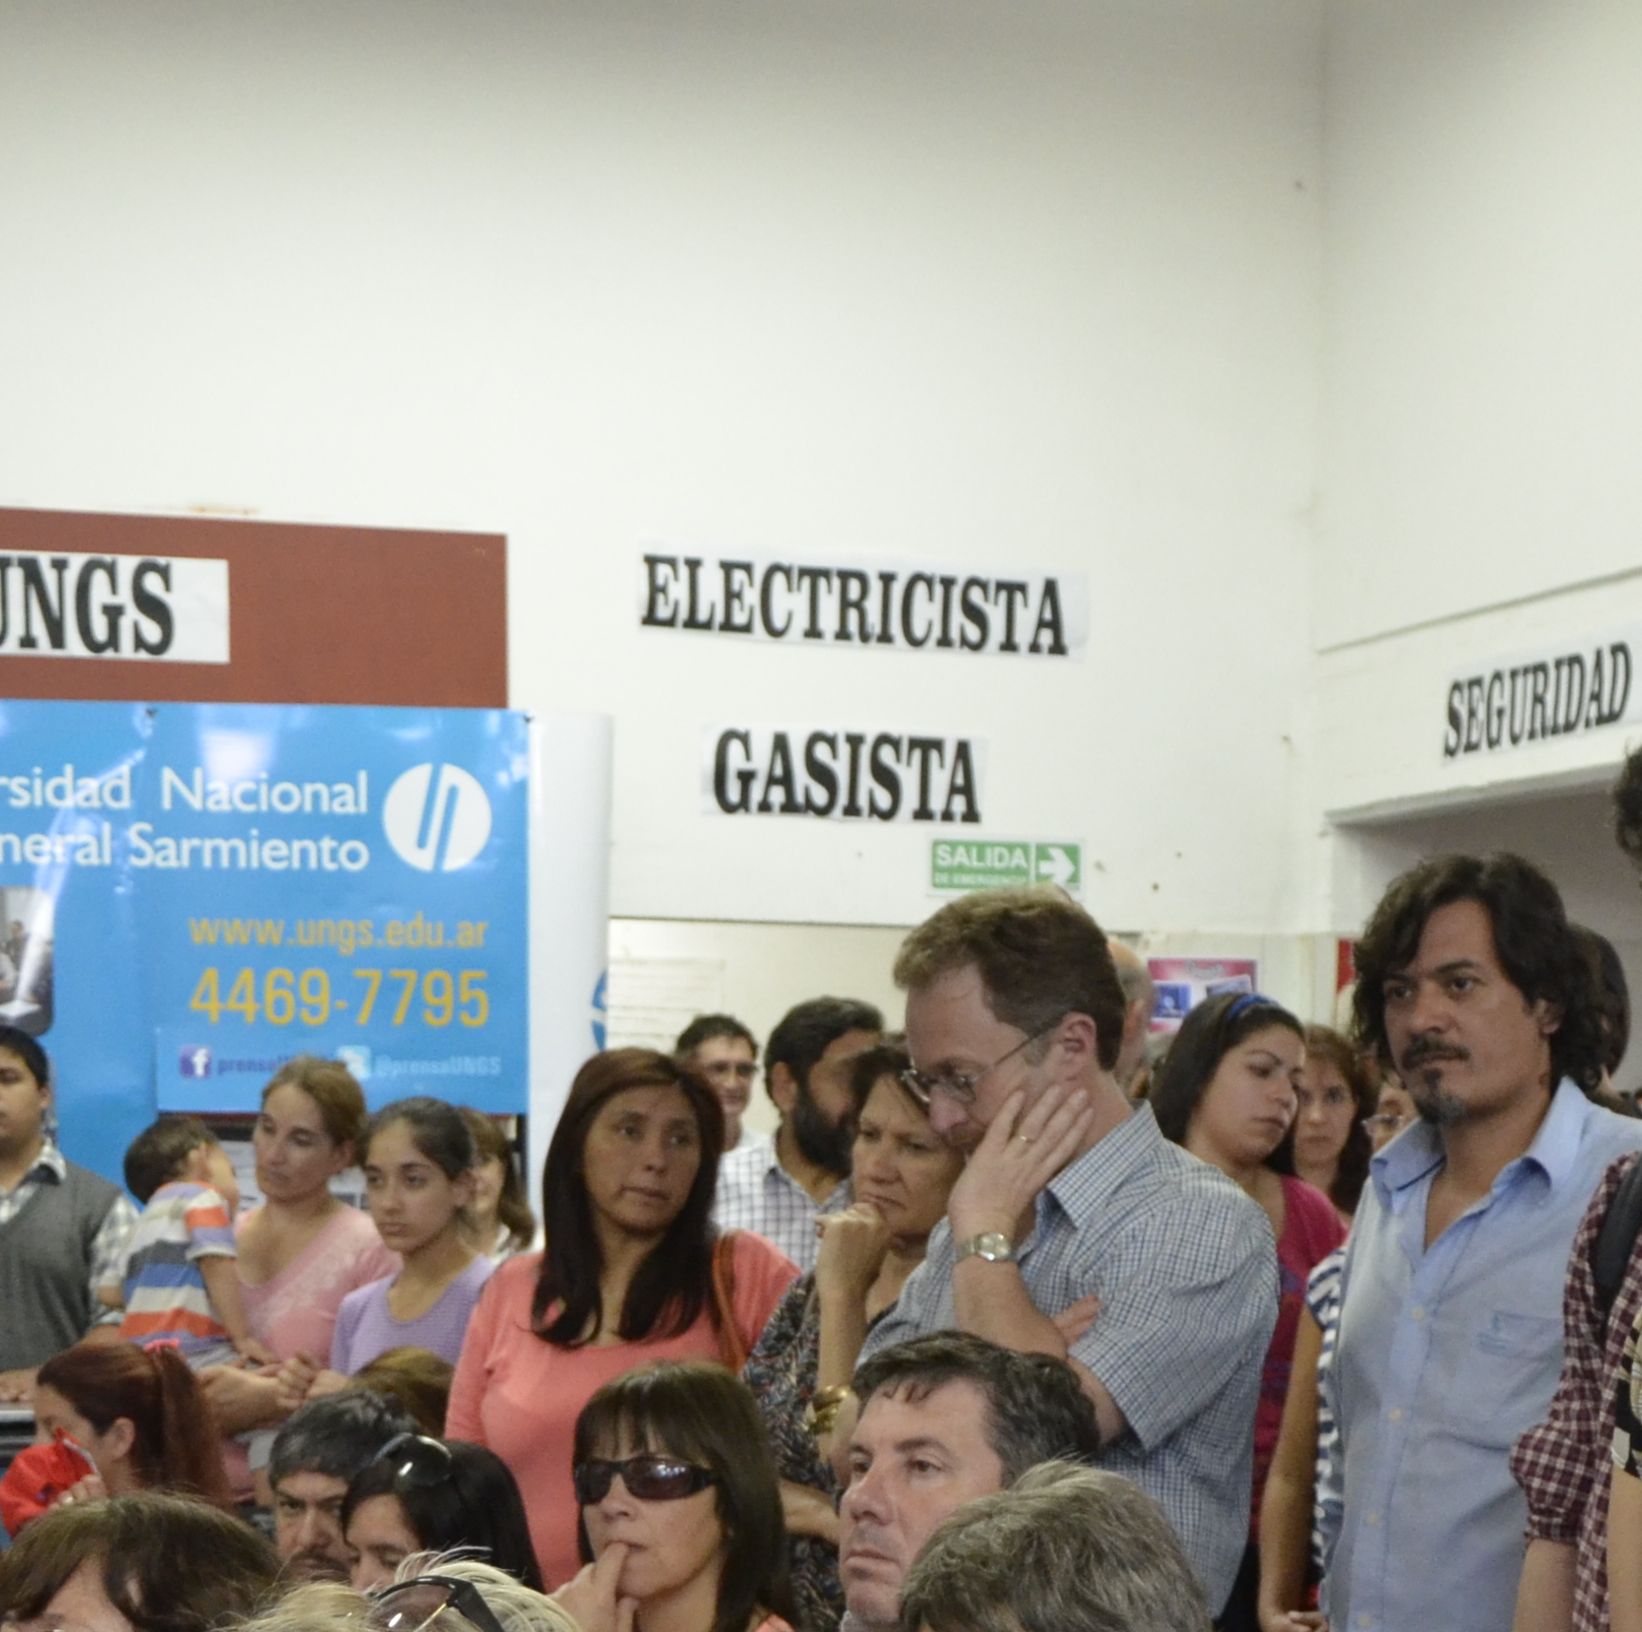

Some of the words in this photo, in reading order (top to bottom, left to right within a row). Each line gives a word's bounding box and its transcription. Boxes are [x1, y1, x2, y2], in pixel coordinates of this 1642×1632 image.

[640, 554, 1068, 656] ELECTRICISTA
[1443, 641, 1632, 758] SEGURIDAD
[161, 766, 368, 815] Nacional
[713, 728, 982, 824] GASISTA
[129, 823, 370, 872] Sarmiento
[936, 844, 1028, 869] SALIDA
[189, 913, 489, 955] www.ungs.edu.ar
[189, 967, 490, 1028] 4469-7795
